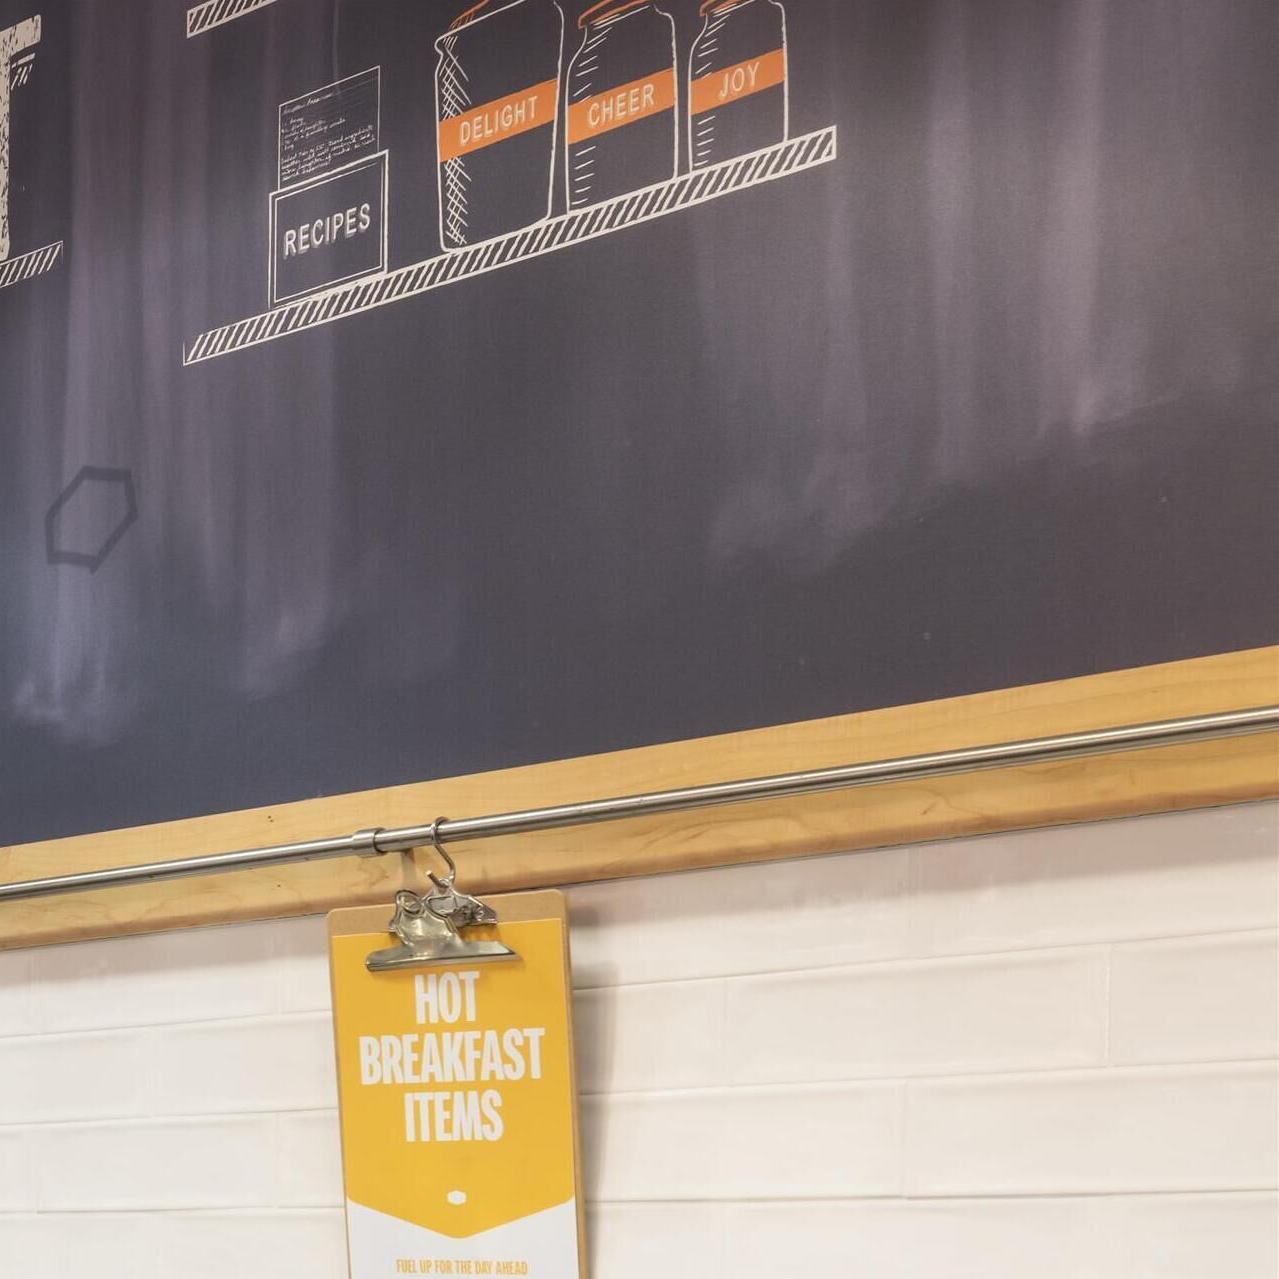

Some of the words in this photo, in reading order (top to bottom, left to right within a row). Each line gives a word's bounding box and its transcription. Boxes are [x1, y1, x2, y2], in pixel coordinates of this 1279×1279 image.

[587, 84, 655, 128] CHEER
[719, 62, 760, 99] JOY
[459, 96, 538, 146] DELIGHT
[284, 203, 371, 258] RECIPES
[414, 970, 480, 1025] HOT
[359, 1027, 546, 1085] BREAKFAST
[403, 1089, 504, 1142] ITEMS
[396, 1259, 417, 1273] FUEL
[420, 1259, 432, 1273] UP
[434, 1259, 452, 1274] FOR
[455, 1260, 472, 1274] THE
[474, 1261, 493, 1275] DAY
[495, 1261, 528, 1275] AHEAD
